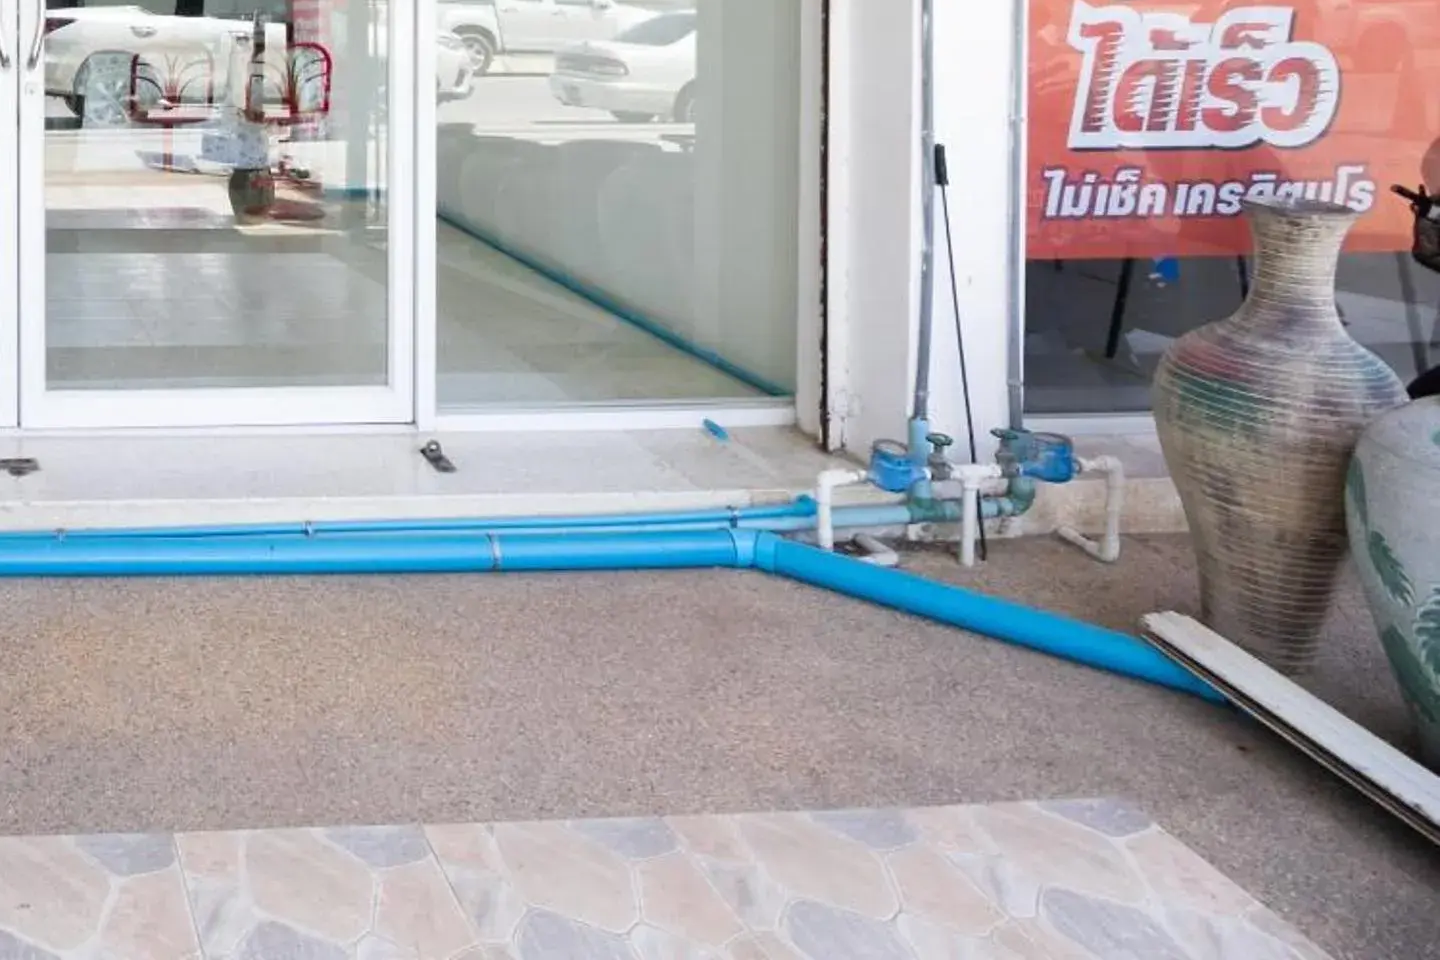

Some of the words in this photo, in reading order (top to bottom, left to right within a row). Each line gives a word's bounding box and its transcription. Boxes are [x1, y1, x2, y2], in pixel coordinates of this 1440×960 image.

[1073, 10, 1333, 138] ได้เร็ว
[1044, 169, 1166, 216] ไม่เช็ค
